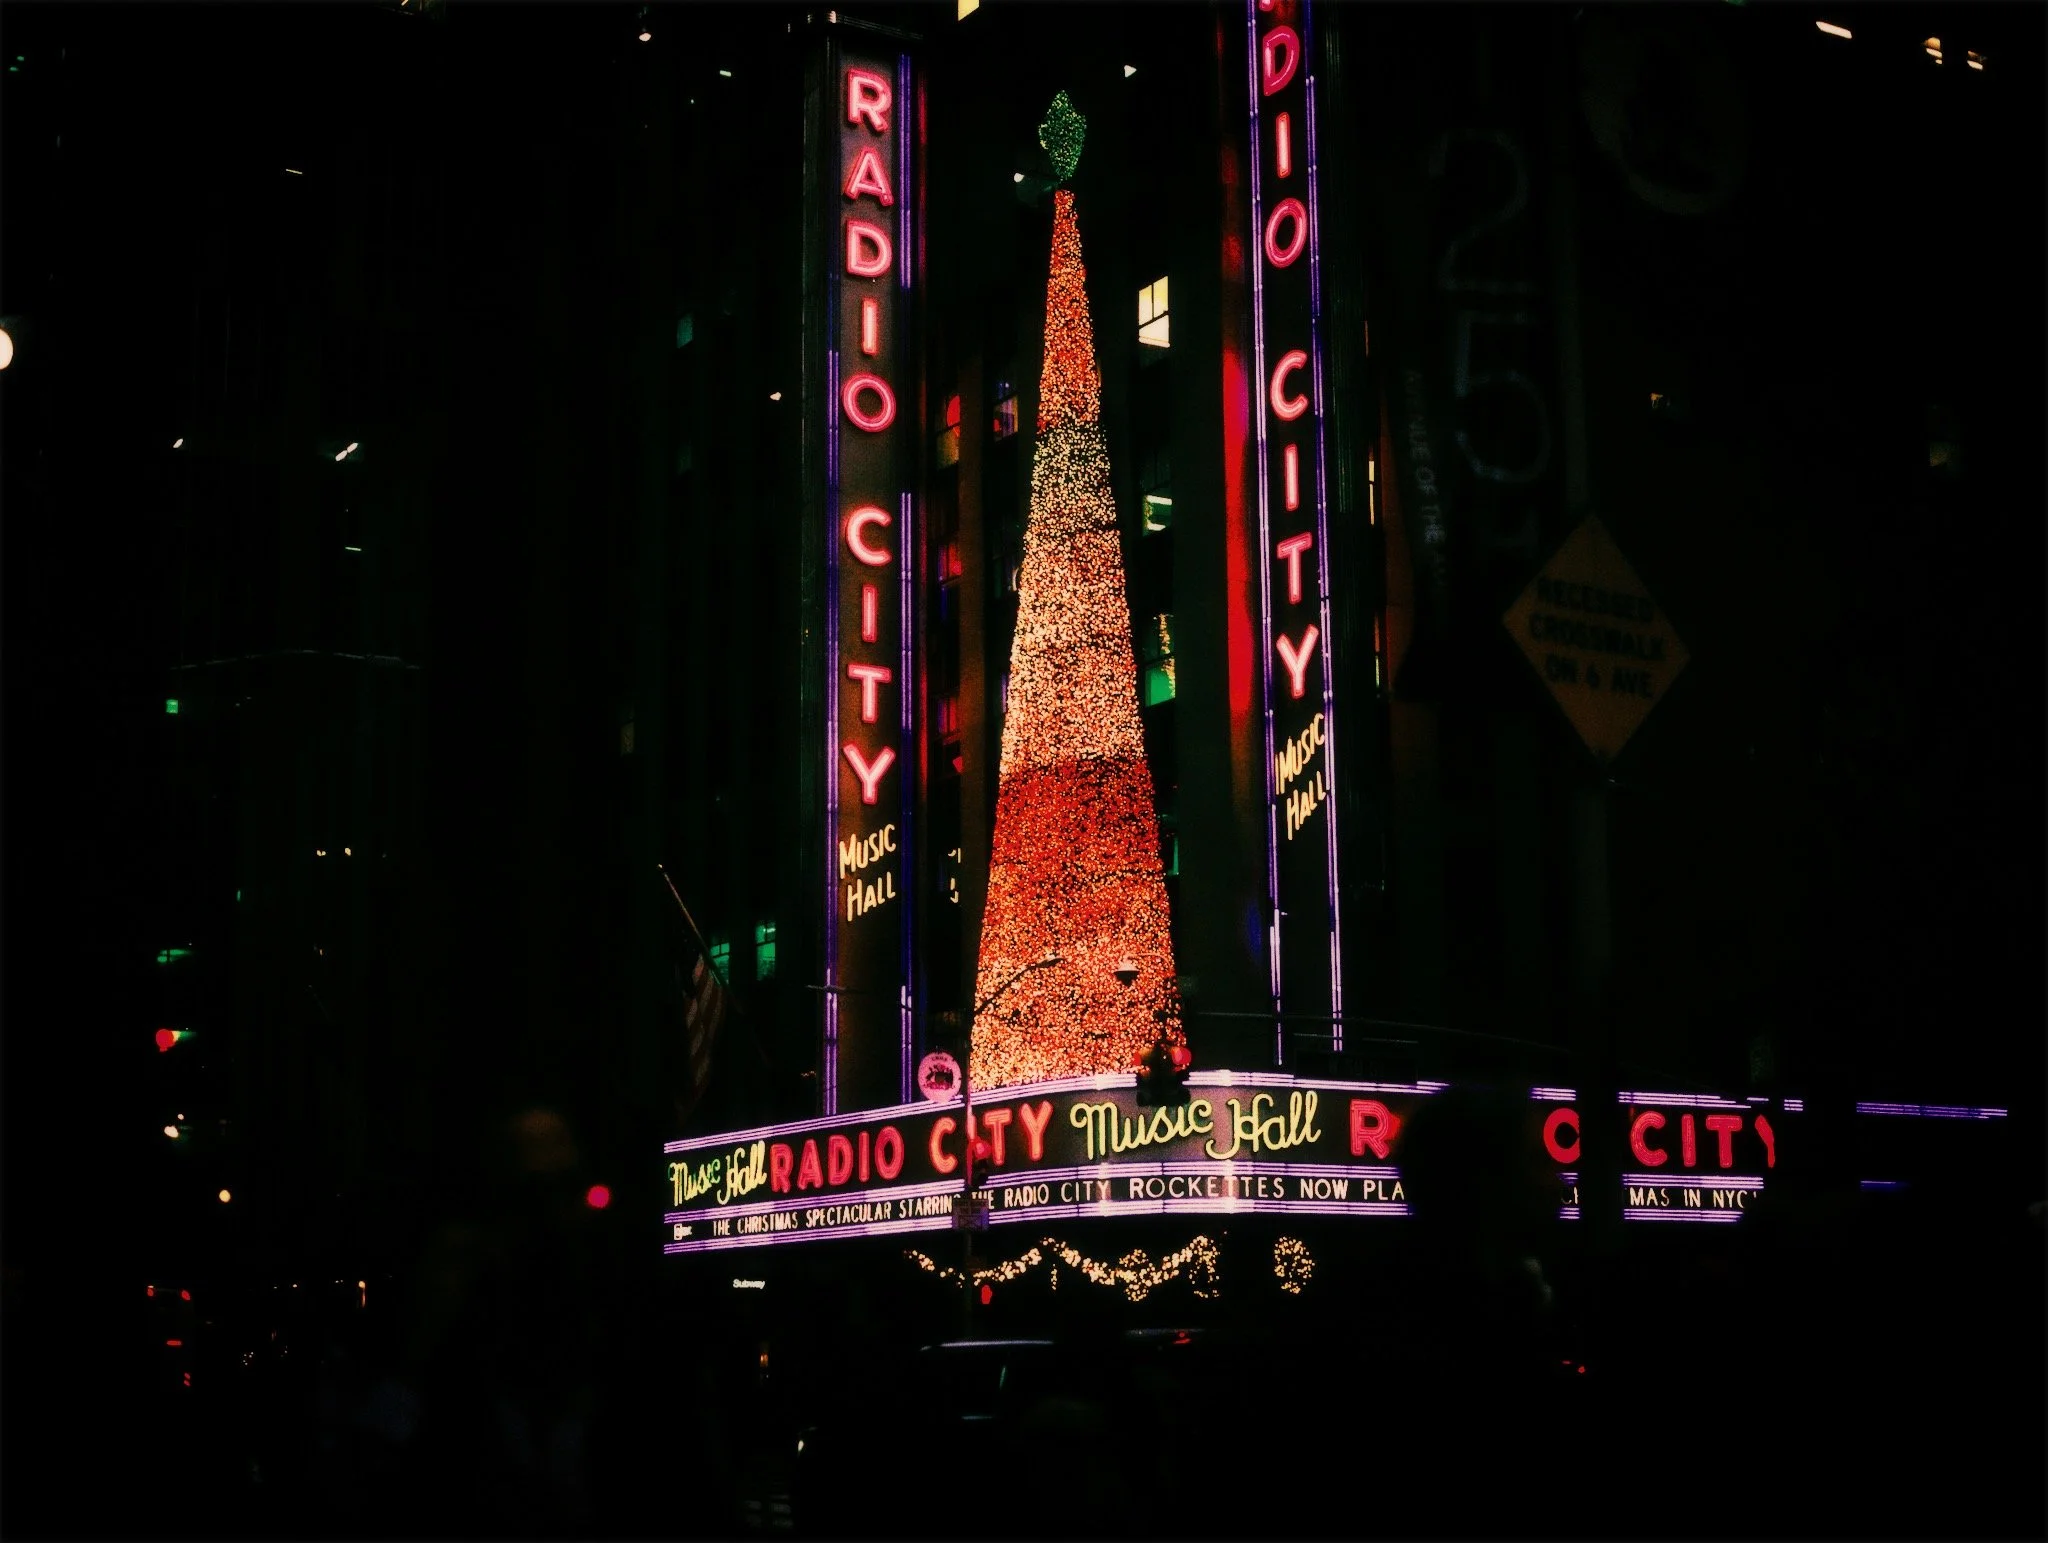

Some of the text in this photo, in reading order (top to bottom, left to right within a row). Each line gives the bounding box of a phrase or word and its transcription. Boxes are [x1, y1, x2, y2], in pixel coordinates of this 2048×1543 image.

[1259, 0, 1319, 699] DIO CITY
[843, 68, 897, 805] RADIO CITY
[1275, 712, 1325, 795] MUSIC
[1286, 770, 1327, 840] HALL
[839, 823, 897, 880] MUSIC
[847, 871, 896, 921] HALL
[668, 1157, 721, 1206] Music
[716, 1139, 768, 1205] Hall
[769, 1125, 905, 1194] RADIO
[1069, 1100, 1214, 1160] Music
[1205, 1090, 1322, 1160] Hall
[712, 1218, 731, 1236] THE
[736, 1210, 799, 1236] CHRISTMAS
[805, 1200, 892, 1229] SPECTACULAR
[898, 1194, 961, 1218] STARRIN
[1004, 1182, 1050, 1208] RADIO
[1060, 1180, 1112, 1203] CITY
[1129, 1175, 1285, 1199] ROCKETTES
[1299, 1178, 1349, 1200] NOW
[1363, 1180, 1405, 1201] PLA
[1629, 1186, 1670, 1208] MAS
[1683, 1187, 1701, 1208] IN
[1712, 1189, 1757, 1209] NYC
[732, 1278, 766, 1290] Subway
